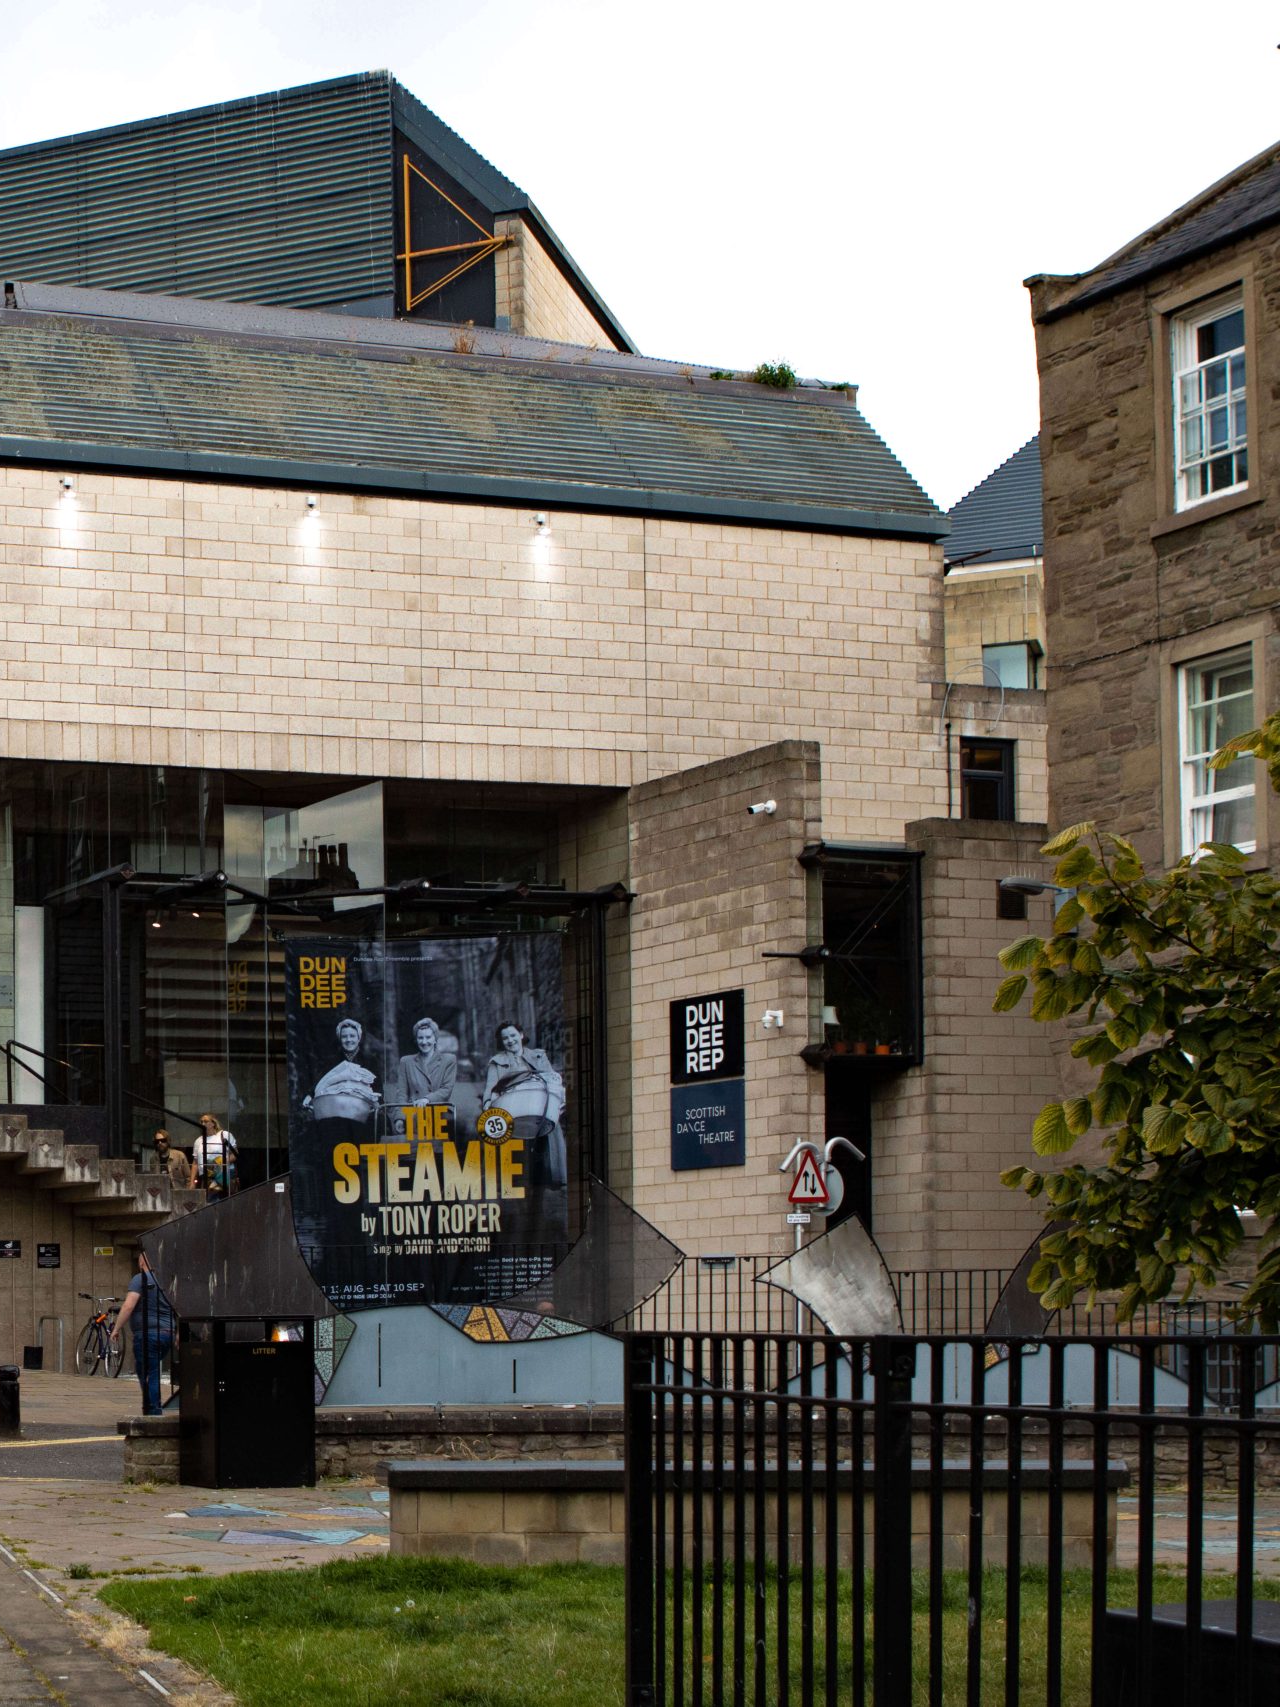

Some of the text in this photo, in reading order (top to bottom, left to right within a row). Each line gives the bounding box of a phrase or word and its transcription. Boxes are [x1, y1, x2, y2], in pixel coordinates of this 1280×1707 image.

[299, 956, 346, 973] DUN
[299, 974, 346, 991] DEE
[300, 992, 347, 1008] REP
[685, 1000, 724, 1027] DUN
[685, 1024, 724, 1051] DEE
[686, 1048, 725, 1074] REP
[685, 1105, 726, 1120] SCOTTISH
[401, 1106, 449, 1141] THE
[487, 1118, 504, 1133] 35
[698, 1130, 735, 1145] THEATRE
[332, 1138, 526, 1204] STEAMIE
[361, 1202, 501, 1237] by TONY ROPER
[373, 1244, 391, 1255] Sngs
[404, 1239, 434, 1254] DAVID
[436, 1237, 491, 1253] ANDERSON
[343, 1284, 364, 1293] AUG
[373, 1284, 392, 1292] SAT
[394, 1283, 405, 1292] 10
[252, 1347, 276, 1355] LITTER
